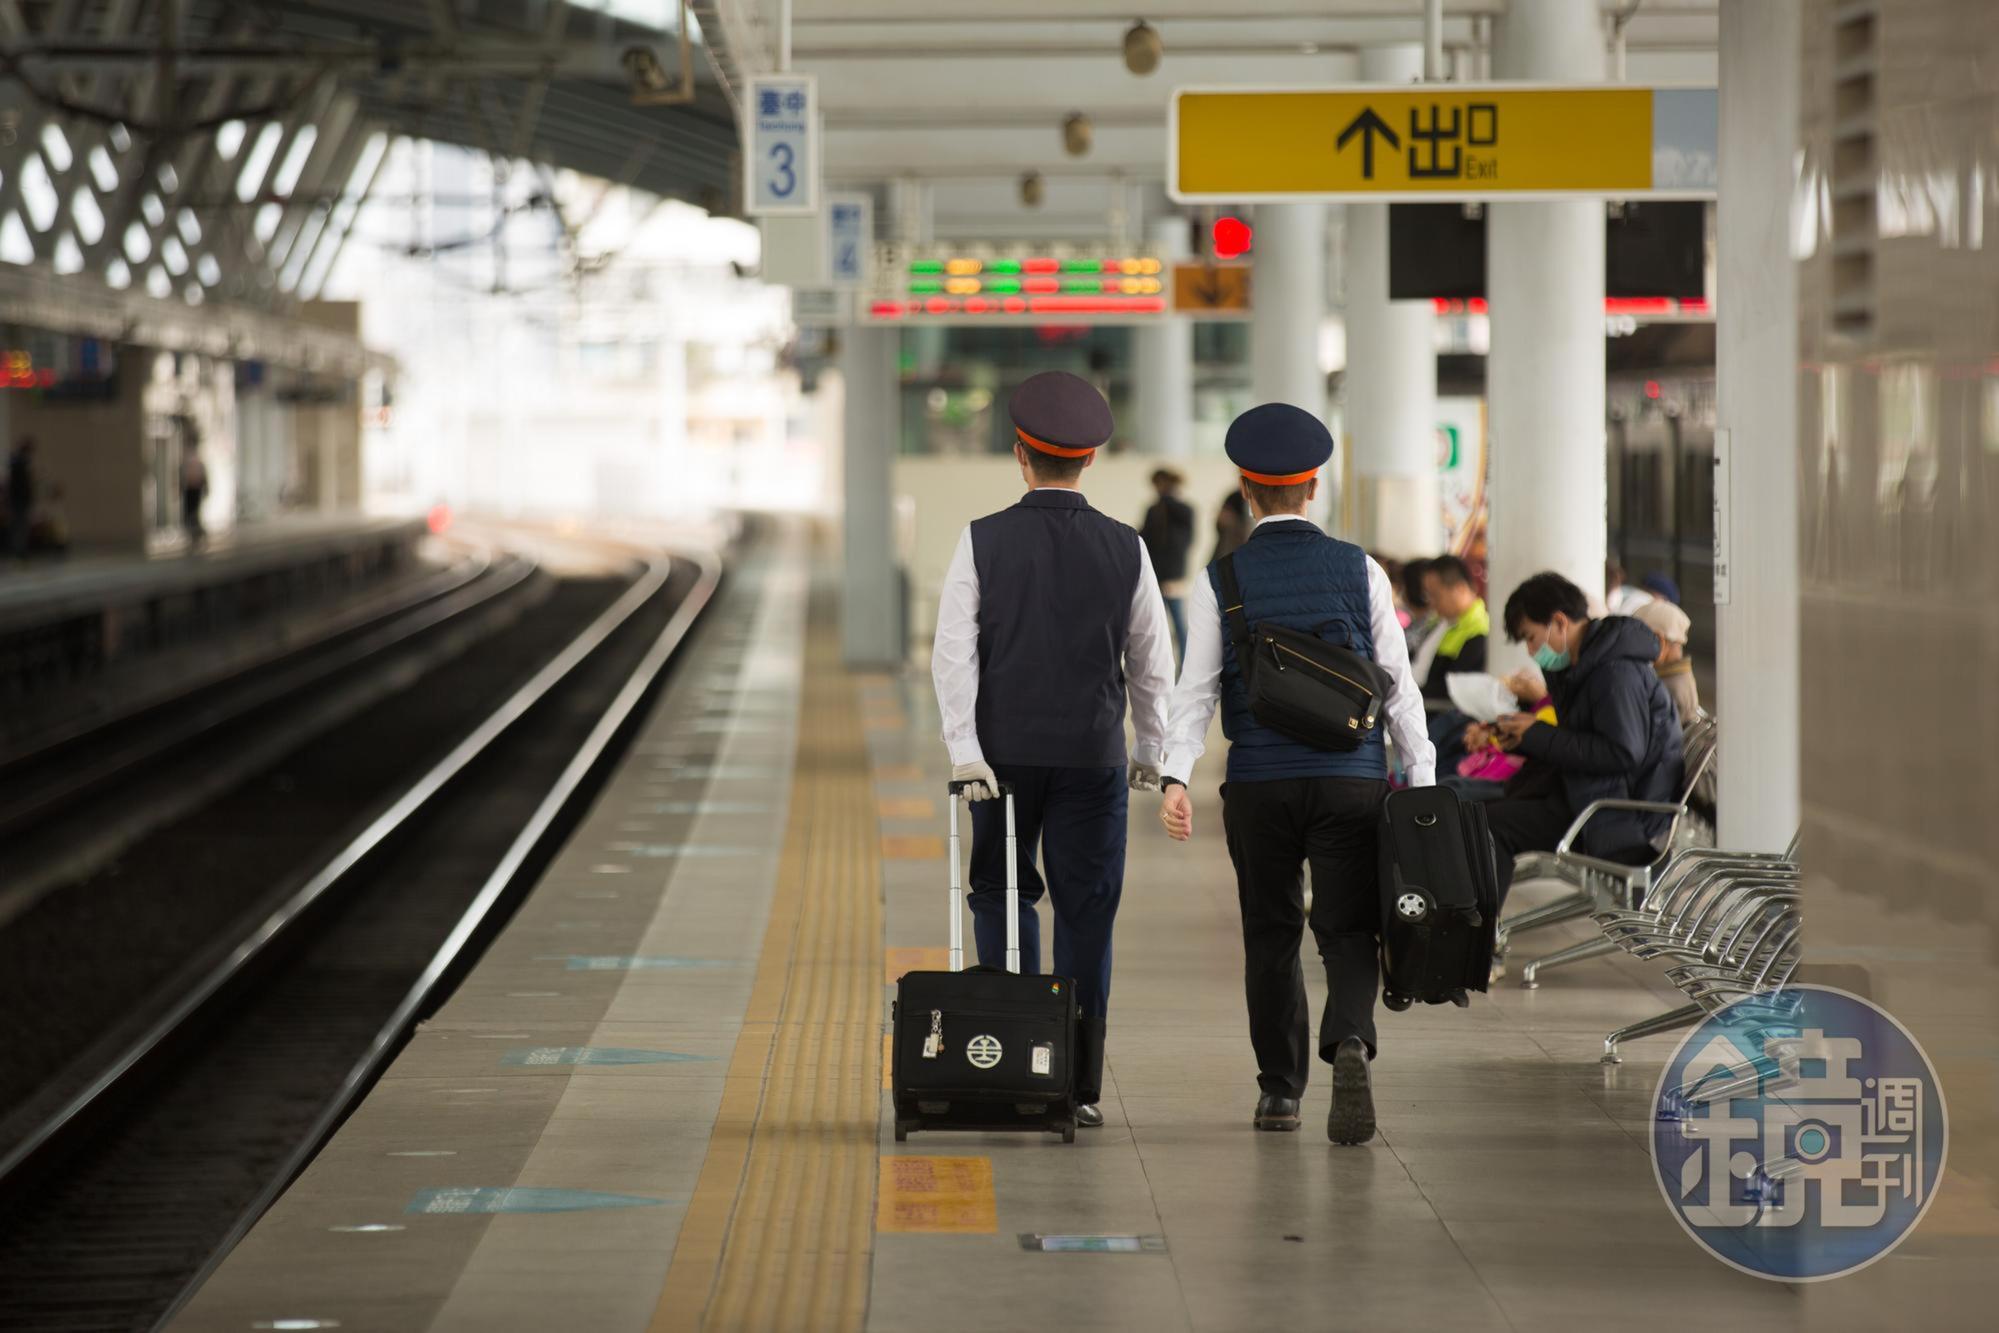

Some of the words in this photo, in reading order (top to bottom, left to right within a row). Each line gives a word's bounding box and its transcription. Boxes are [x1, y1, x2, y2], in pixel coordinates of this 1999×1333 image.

[1408, 103, 1498, 179] 出口
[1466, 155, 1498, 180] Exit
[769, 142, 796, 198] 3
